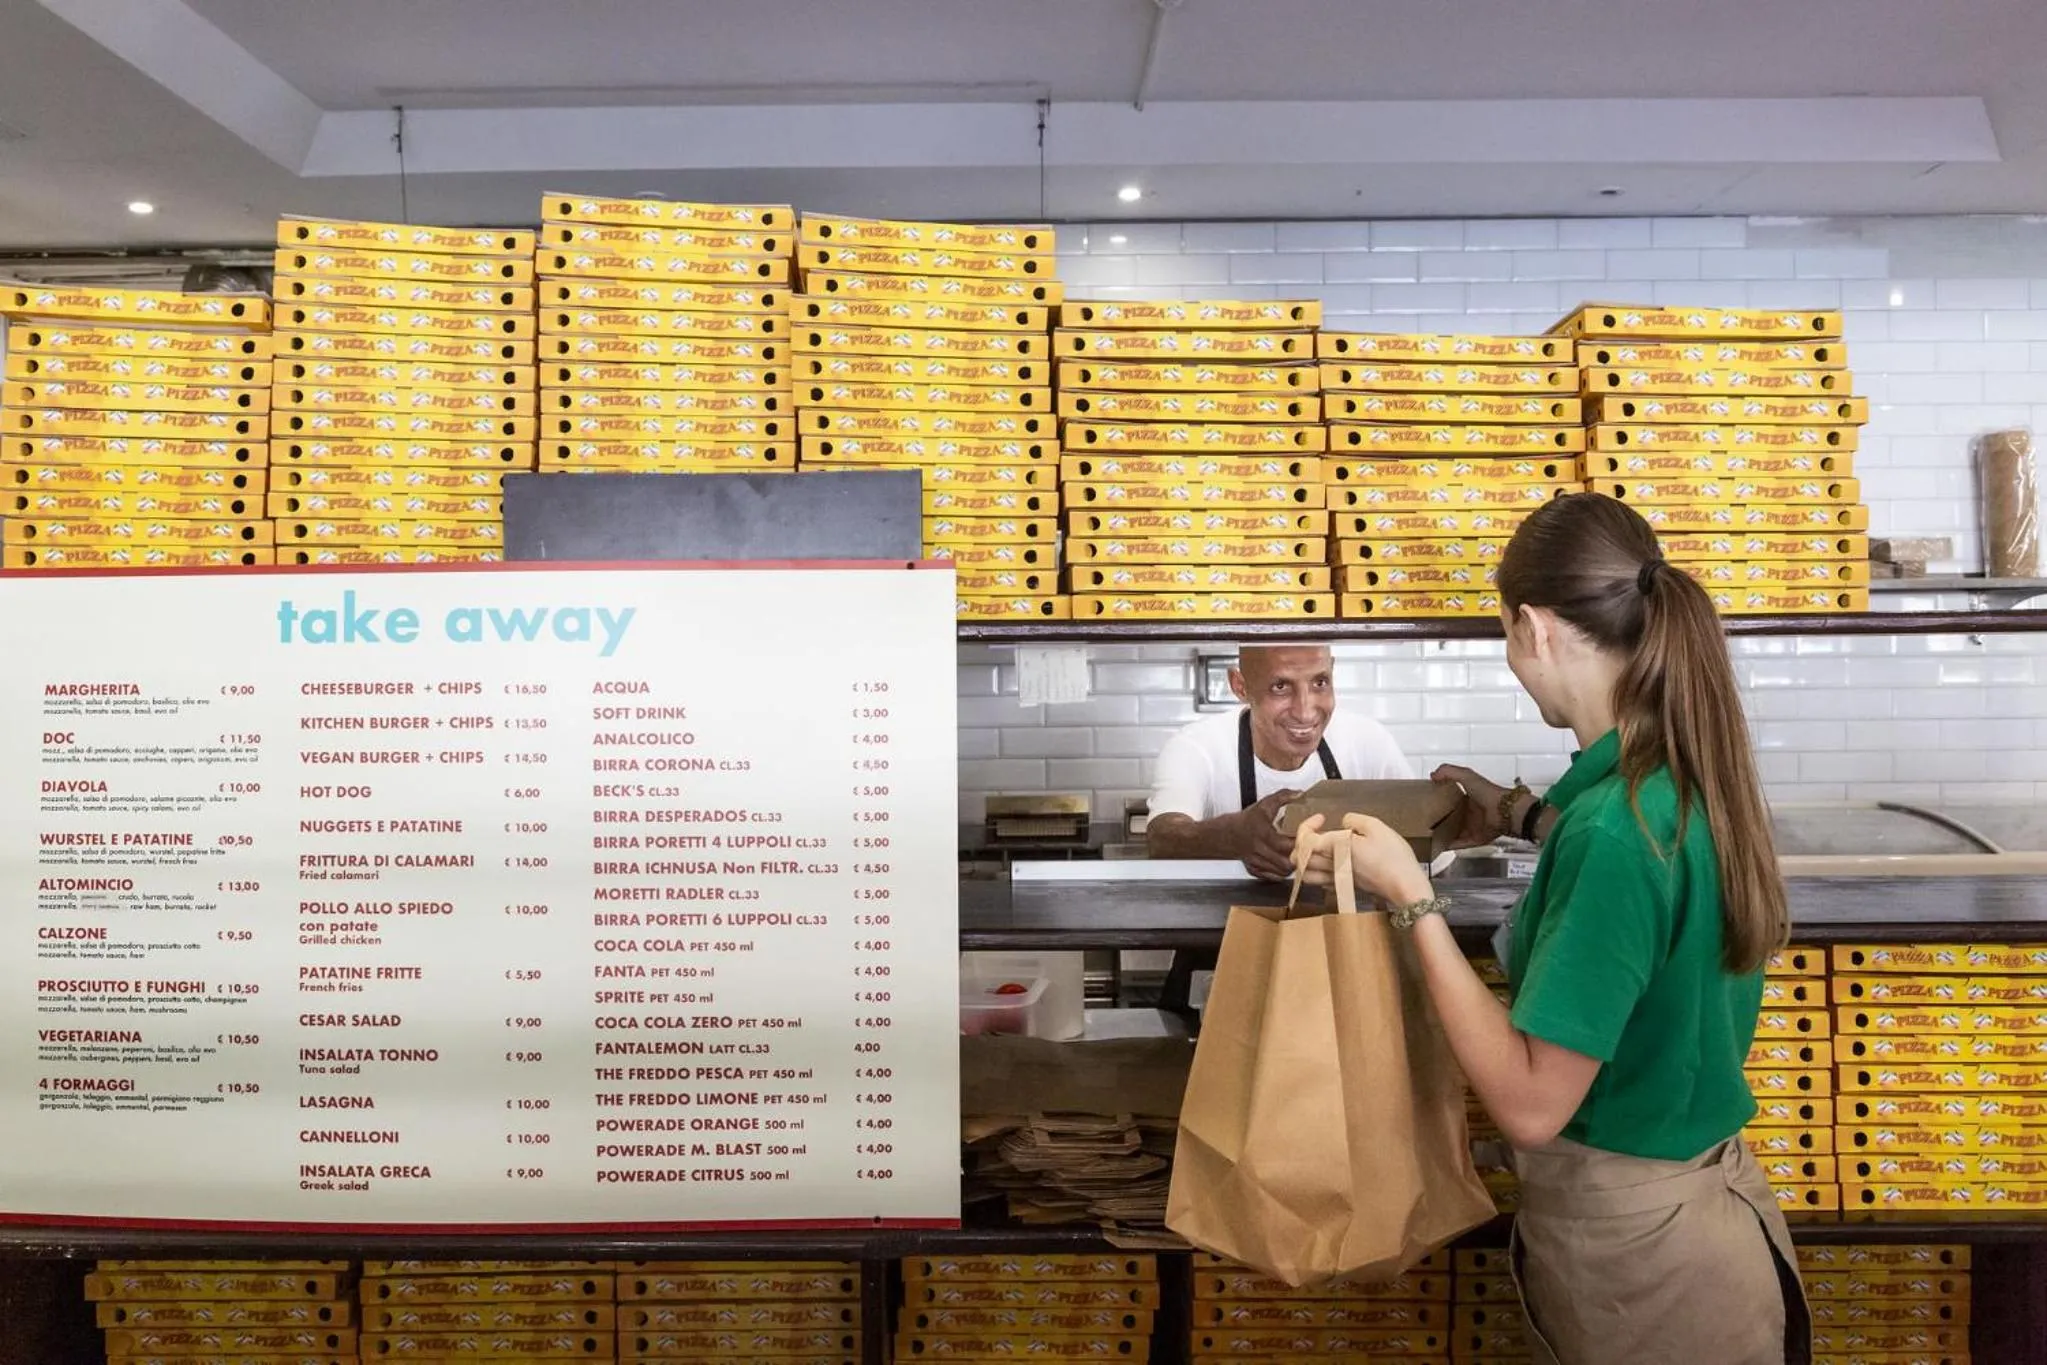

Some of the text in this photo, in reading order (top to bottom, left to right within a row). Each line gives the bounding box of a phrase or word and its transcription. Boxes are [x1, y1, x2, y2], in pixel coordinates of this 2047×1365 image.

[599, 202, 640, 216] PIZZA
[337, 229, 378, 240] PIZZA
[859, 225, 900, 239] PIZZA
[57, 293, 101, 307] PIZZA
[1122, 306, 1165, 319] PIZZA
[1642, 315, 1685, 327] PIZZA
[1378, 339, 1419, 353] PIZZA
[277, 590, 634, 655] take away
[45, 684, 254, 696] MARGHERITA 9,00
[301, 682, 482, 695] CHEESEBURGER CHIPS
[592, 682, 889, 694] ACQUA 1,50
[593, 707, 888, 720] SOFT DRINK 3,00
[301, 717, 493, 729] KITCHEN BURGER CHIPS
[44, 732, 261, 744] DOC 11,50
[593, 733, 889, 745] ANALCOLICO 4,00
[300, 752, 547, 764] VEGAN BURGER CHIPS 14,50
[593, 759, 715, 771] BIRRA CORONA
[42, 781, 260, 794] DIAVOLA 10,00
[301, 786, 540, 798] HOT DOG 6,00
[594, 785, 888, 797] BECK'S CL.33 5,00
[594, 810, 747, 822] BIRRA DESPERADOS
[300, 820, 547, 833] NUGGETS E PATATINE 10,00
[40, 834, 193, 845] WURSTEL E PATATINE
[594, 836, 791, 848] BIRRA PORETTI 4 LUPPOLI
[300, 855, 548, 868] FRITTURA DI CALAMARI 14,00
[594, 862, 889, 874] BIRRA ICHNUSA Non FILTR. CL.33 4,50
[300, 870, 379, 880] Fried calamari
[39, 879, 259, 892] ALTOMINCIO 13,00
[594, 888, 724, 900] MORETTI RADLER
[300, 902, 548, 916] POLLO ALLO SPIEDO 10,00
[594, 913, 792, 926] BIRRA PORETTI 6 LUPPOLI
[38, 928, 252, 940] CALZONE 9,50
[300, 921, 378, 934] con patate
[300, 935, 381, 944] Grilled chicken
[594, 940, 753, 952] COCA COLA PET 450 ml
[300, 967, 541, 980] PATATINE FRITTE 5,50
[595, 965, 646, 978] FANTA
[38, 980, 259, 994] PROSCIUTTO E FUNGHI 10,50
[300, 982, 363, 992] French fries
[1890, 985, 1932, 996] PIZZA
[595, 991, 644, 1003] SPRITE
[300, 1014, 541, 1028] CESAR SALAD 9,00
[595, 1016, 732, 1029] COCA COLA ZERO
[38, 1030, 259, 1045] VEGETARIANA 10,50
[596, 1042, 769, 1055] FANTALEMON LATT CL.33
[300, 1048, 542, 1063] INSALATA TONNO 9,00
[299, 1064, 360, 1074] Tuna salad
[595, 1067, 744, 1080] THE FREDDO PESCA
[39, 1078, 259, 1094] 4 FORMAGGI 10,50
[300, 1096, 550, 1110] LASAGNA 10,00
[595, 1093, 758, 1106] THE FREDDO LIMONE
[596, 1118, 759, 1131] POWERADE ORANGE
[300, 1130, 550, 1144] CANNELLONI 10,00
[597, 1144, 762, 1157] POWERADE M. BLAST
[300, 1165, 543, 1179] INSALATA GRECA 9,00
[597, 1169, 892, 1182] POWERADE CITRUS 4,00
[300, 1180, 369, 1190] Greek salad
